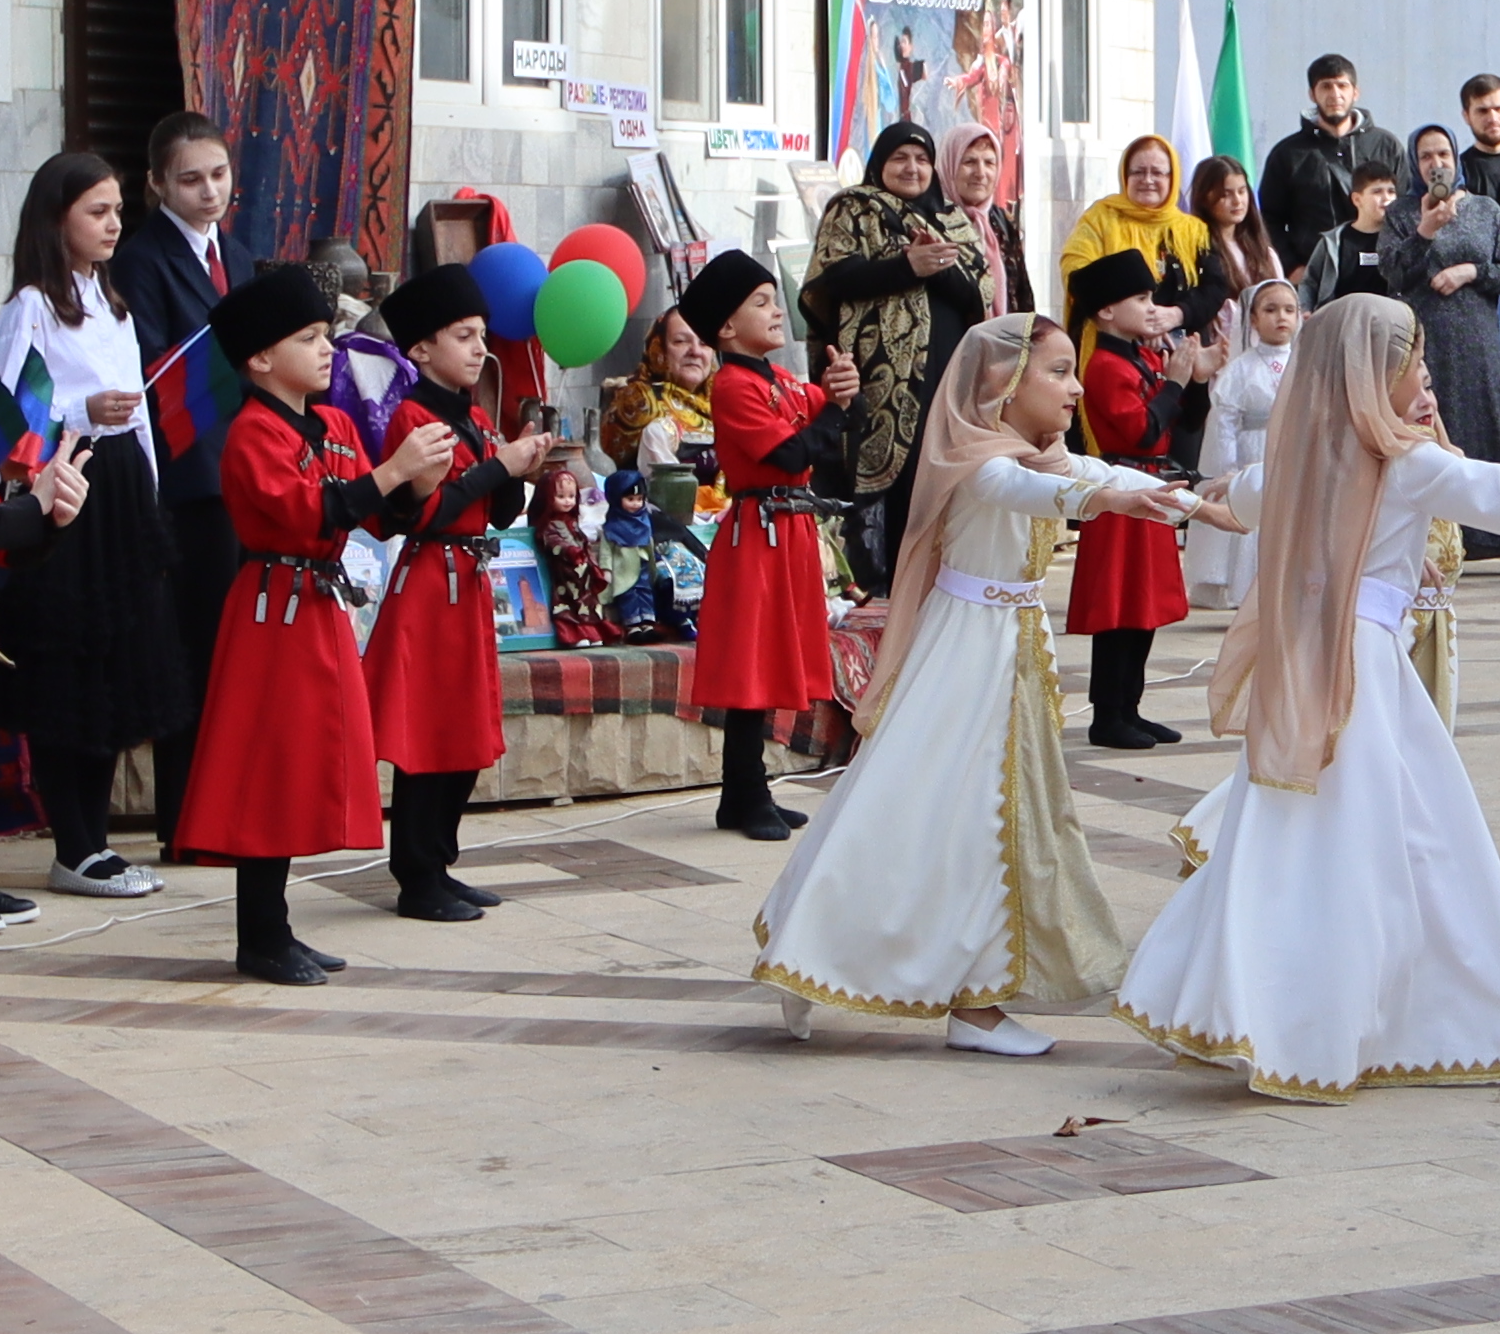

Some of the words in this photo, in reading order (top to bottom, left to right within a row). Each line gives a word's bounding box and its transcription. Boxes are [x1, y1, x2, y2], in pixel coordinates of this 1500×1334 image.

[516, 48, 567, 75] НАРОДЫ
[609, 87, 647, 112] РЕСПУБЛИКА
[619, 119, 646, 140] ОДНА
[709, 128, 740, 153] ЦВЕТИ
[781, 132, 810, 152] МОЯ
